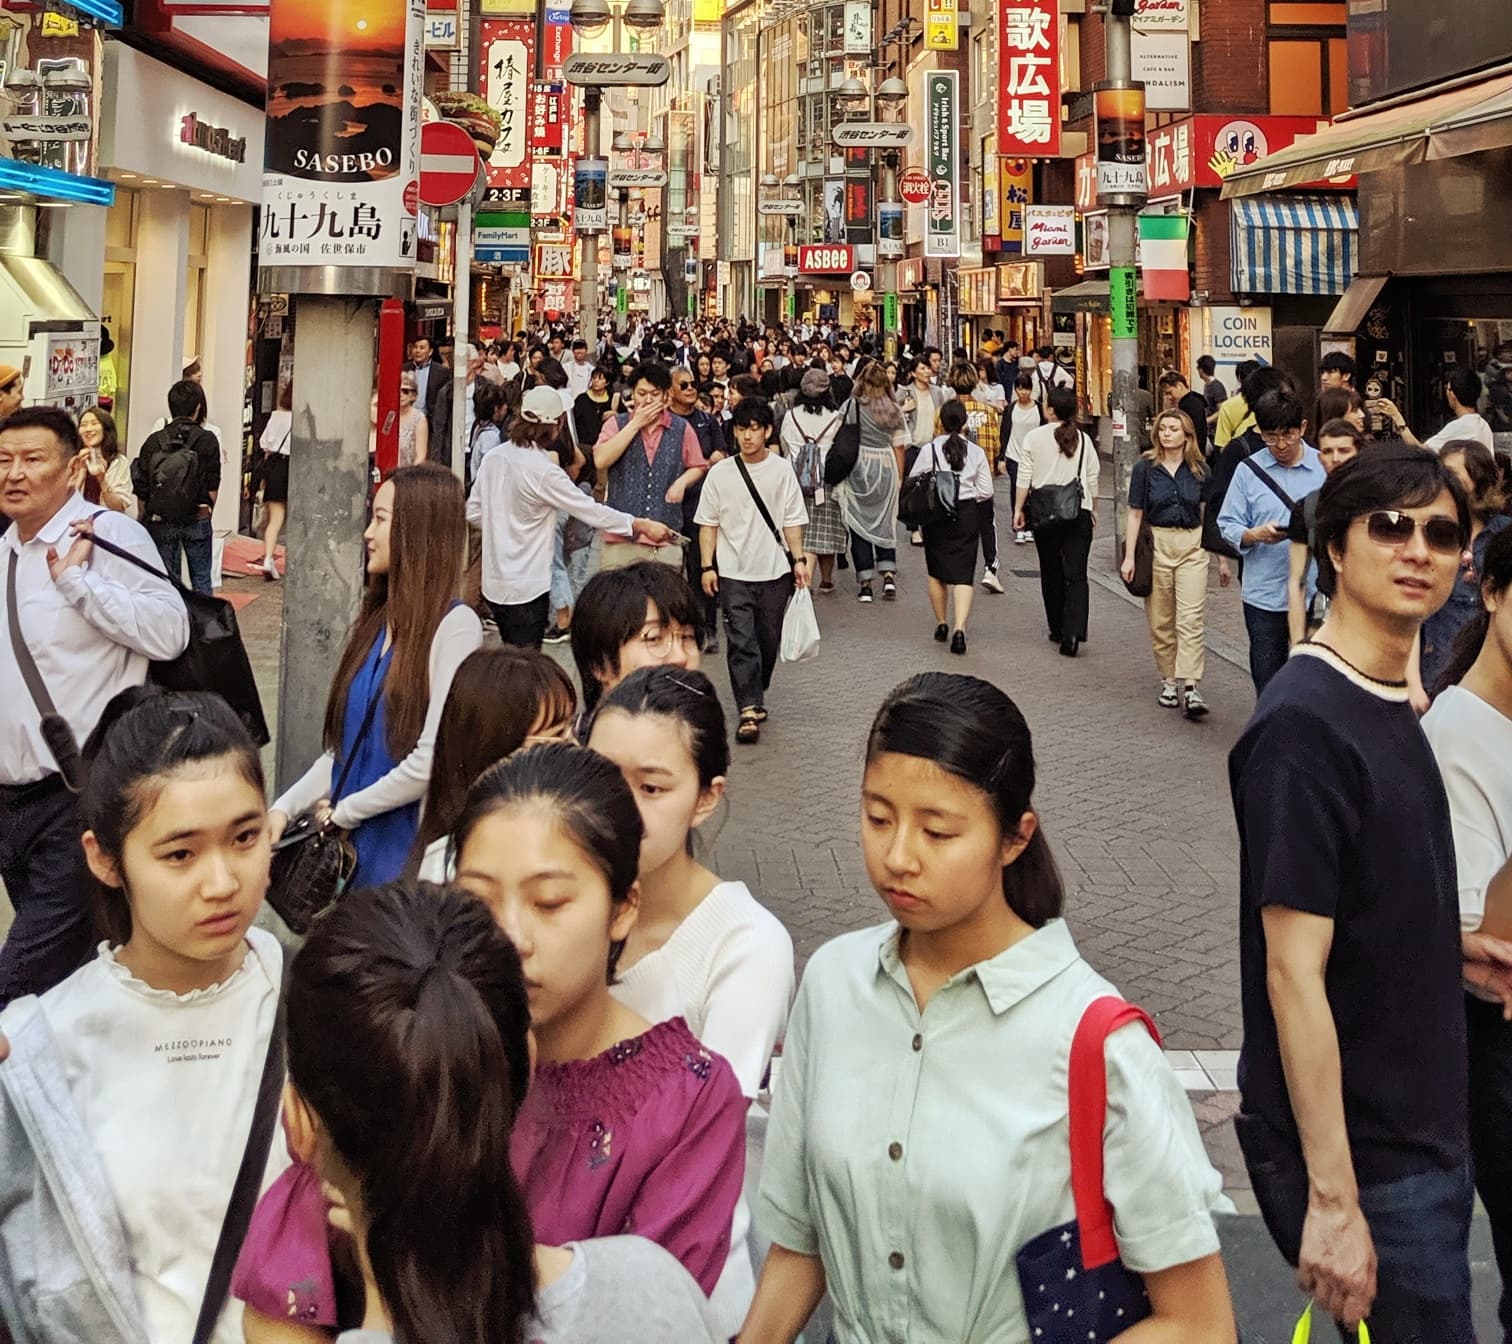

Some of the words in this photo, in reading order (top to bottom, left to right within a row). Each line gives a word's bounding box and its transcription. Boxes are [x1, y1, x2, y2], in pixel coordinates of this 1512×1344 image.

[568, 62, 665, 75] 渋谷センター街
[1006, 7, 1052, 144] 歌広場
[408, 39, 420, 175] きれいな街づくり
[940, 97, 949, 117] Irish
[838, 130, 909, 140] 渋谷センター街
[940, 124, 949, 147] Sport
[294, 146, 393, 174] SASEBO
[941, 148, 949, 161] Bar
[1103, 171, 1144, 184] 九十九島
[903, 181, 930, 195] 消火栓
[278, 190, 358, 200] くじゅうくしま
[262, 202, 382, 240] 九十九島
[1030, 222, 1068, 233] Miami
[478, 232, 518, 241] FamilyMart
[321, 243, 367, 255] 佐世保市
[541, 246, 572, 275] 豚
[1223, 317, 1257, 330] COIN
[1214, 335, 1270, 348] LOCKER
